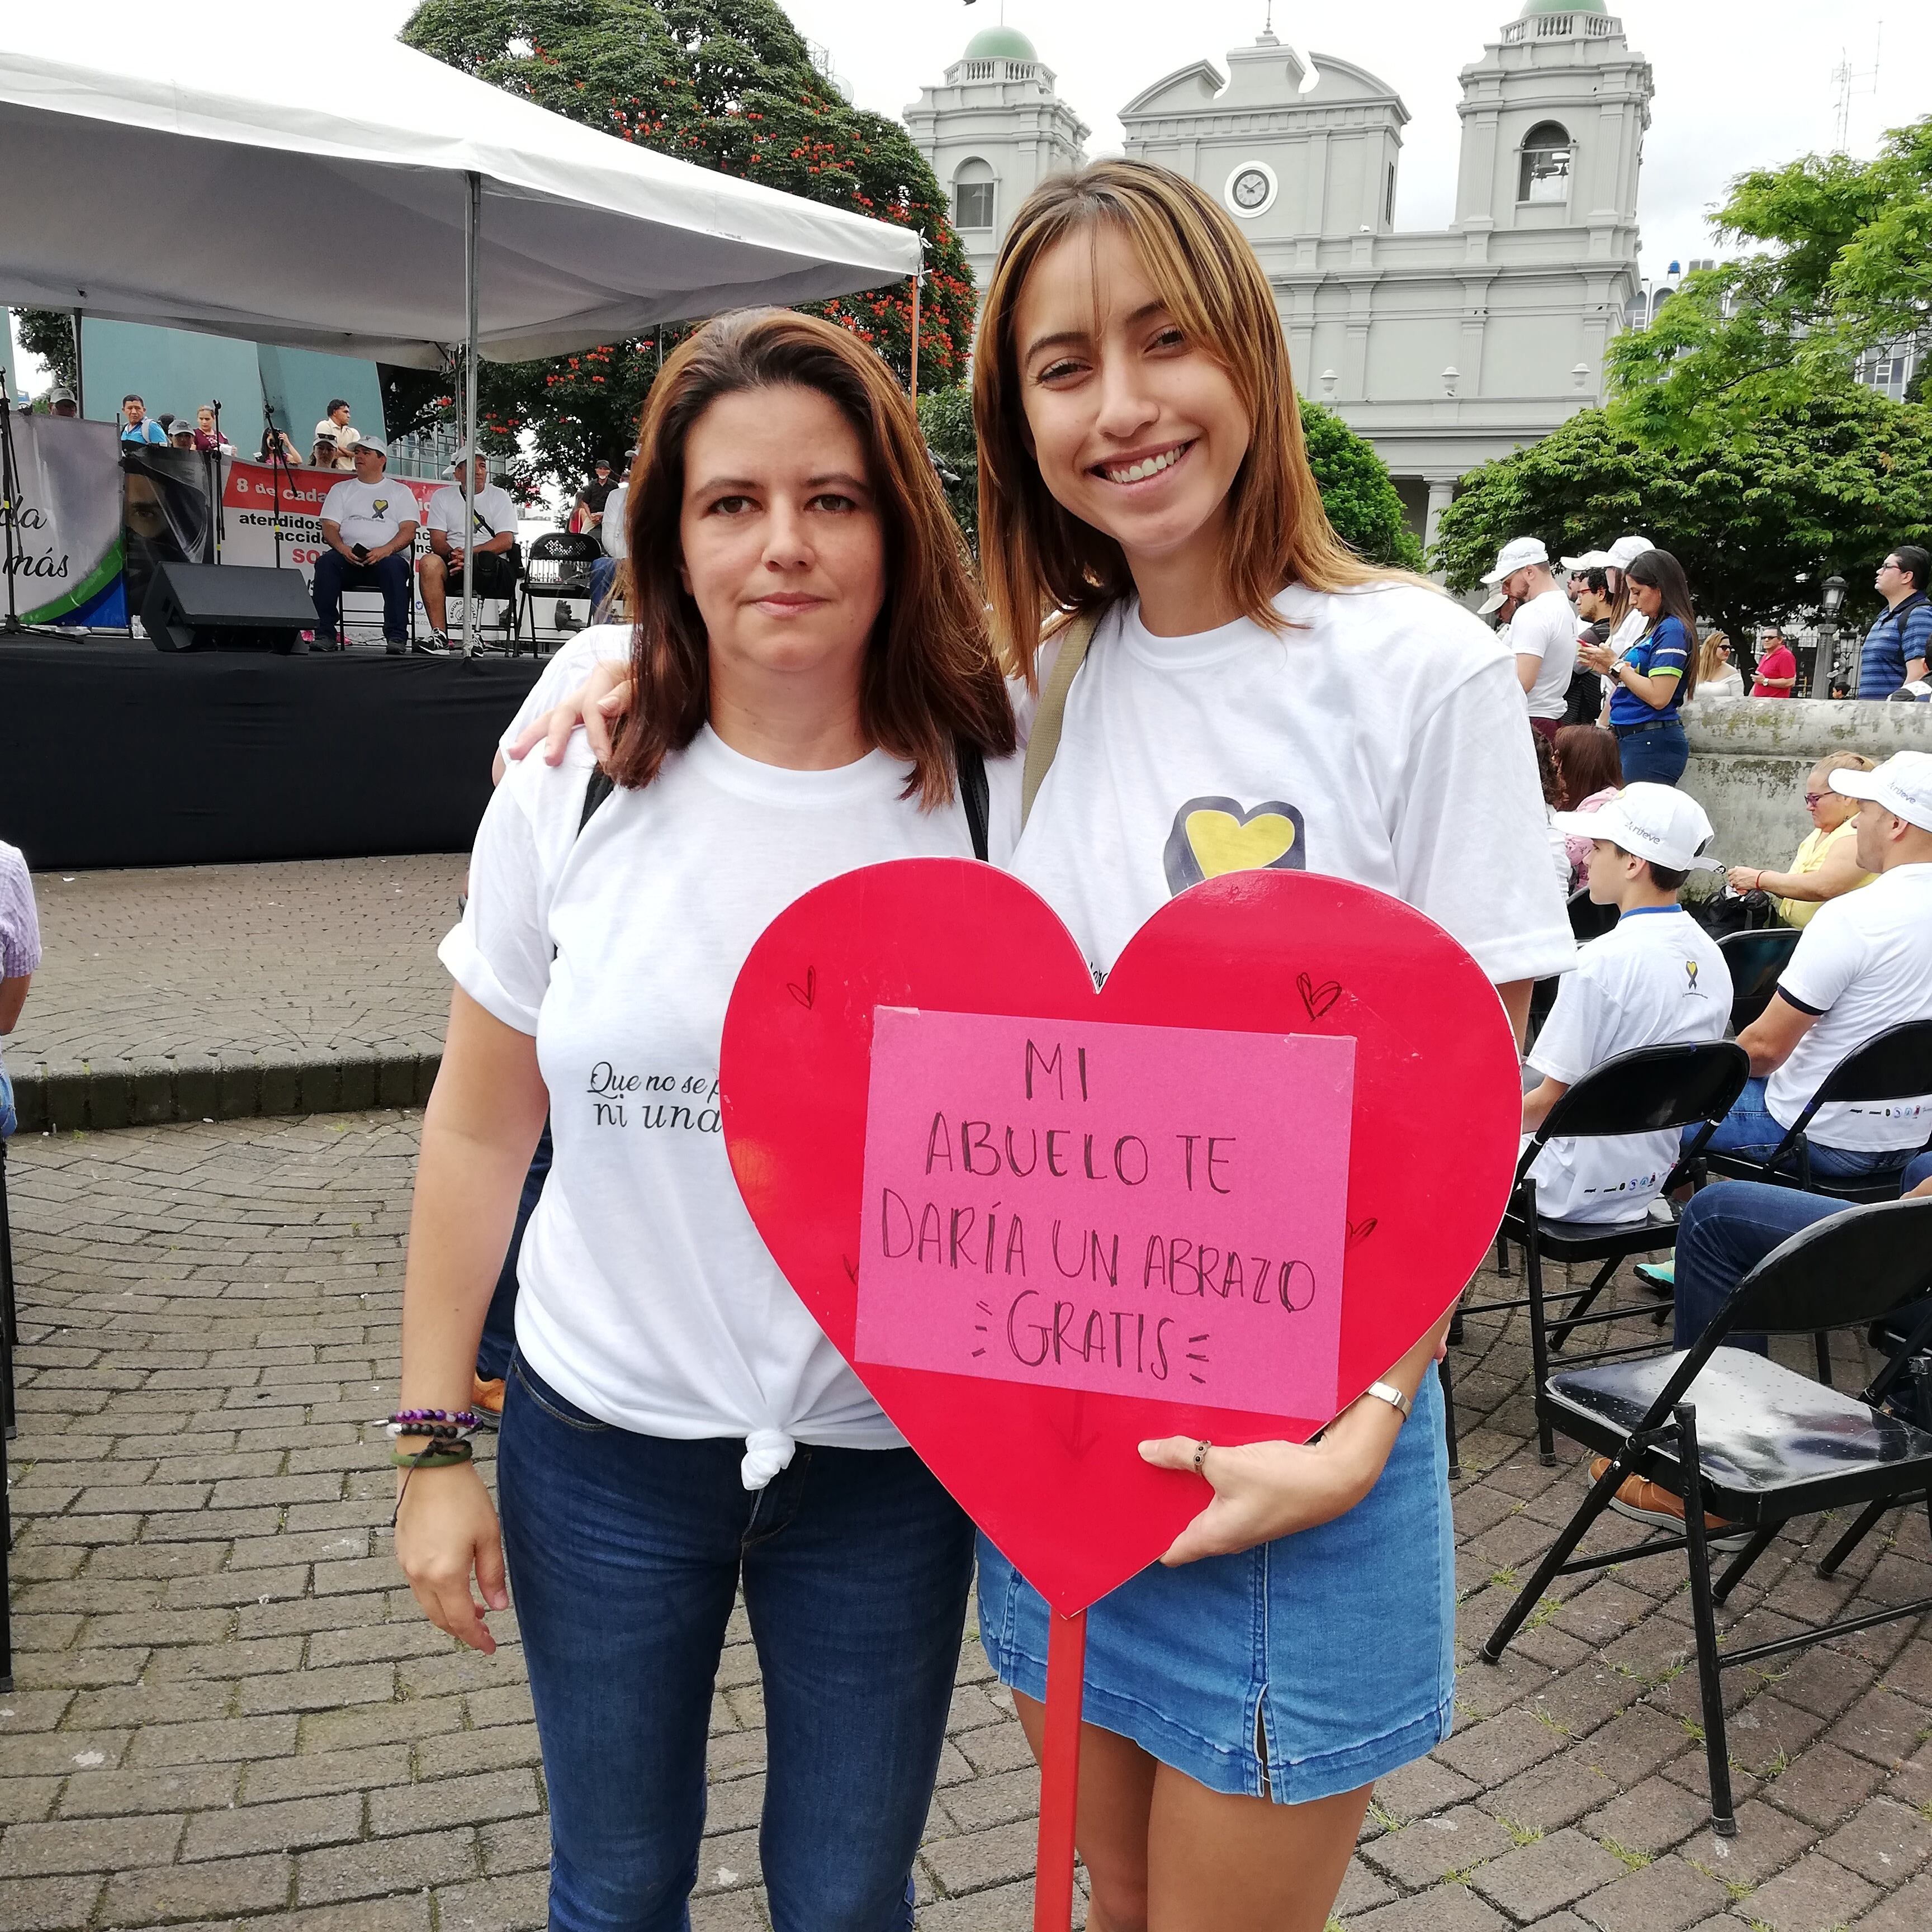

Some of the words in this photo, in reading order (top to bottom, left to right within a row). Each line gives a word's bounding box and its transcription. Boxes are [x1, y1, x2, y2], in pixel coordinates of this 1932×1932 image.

[236, 478, 249, 493] 8
[255, 483, 276, 496] de
[282, 487, 328, 503] cada
[239, 513, 323, 531] atendidos
[2, 547, 69, 577] más
[292, 548, 329, 565] SO
[449, 600, 463, 619] SEGURO
[1632, 826, 1661, 845] riteve
[586, 1061, 642, 1100] Que
[646, 1075, 676, 1091] no
[681, 1076, 708, 1093] se
[1025, 1038, 1088, 1102] MI
[593, 1093, 628, 1128] ni
[642, 1105, 722, 1133] una
[925, 1111, 1149, 1186] ABUELO
[1176, 1134, 1236, 1194] TE
[882, 1187, 1027, 1277] DARÍA
[1052, 1219, 1119, 1287] UN
[1144, 1233, 1317, 1314] ABRAZO
[1007, 1290, 1175, 1381] GRATIS
